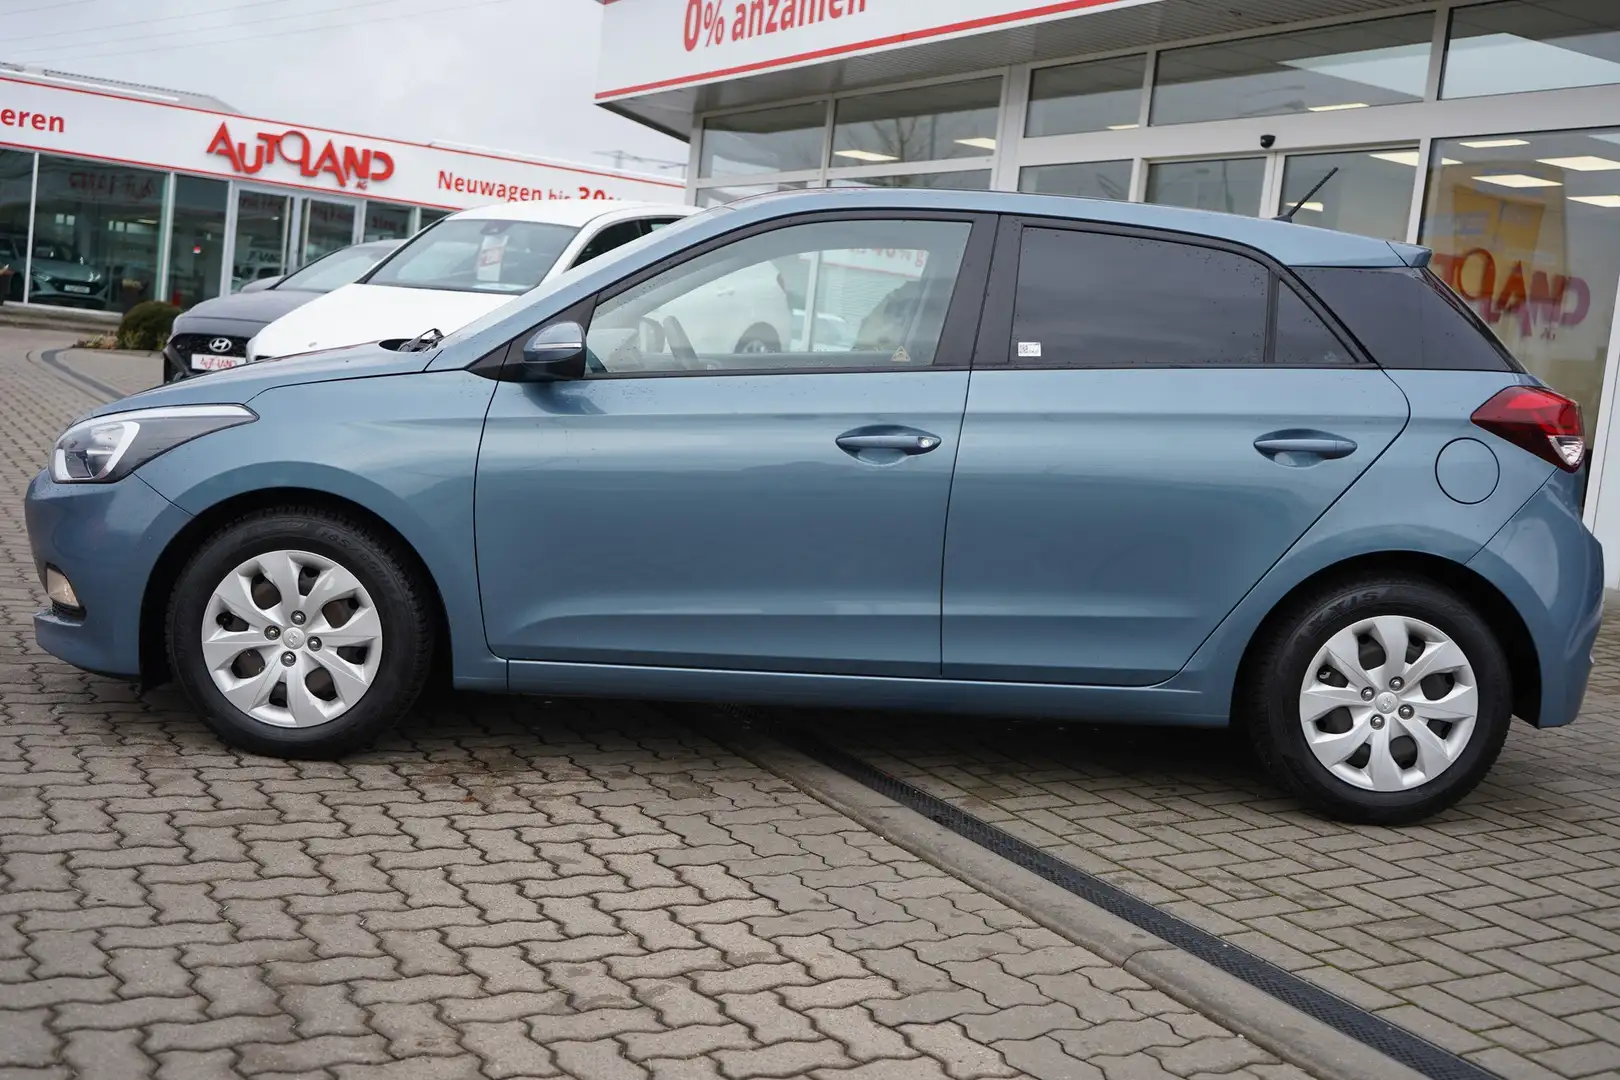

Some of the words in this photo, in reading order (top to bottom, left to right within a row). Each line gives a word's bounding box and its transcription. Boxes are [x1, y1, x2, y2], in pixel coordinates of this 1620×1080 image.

[683, 0, 725, 52] 0%
[0, 108, 65, 133] eren
[438, 170, 542, 200] Neuwagen
